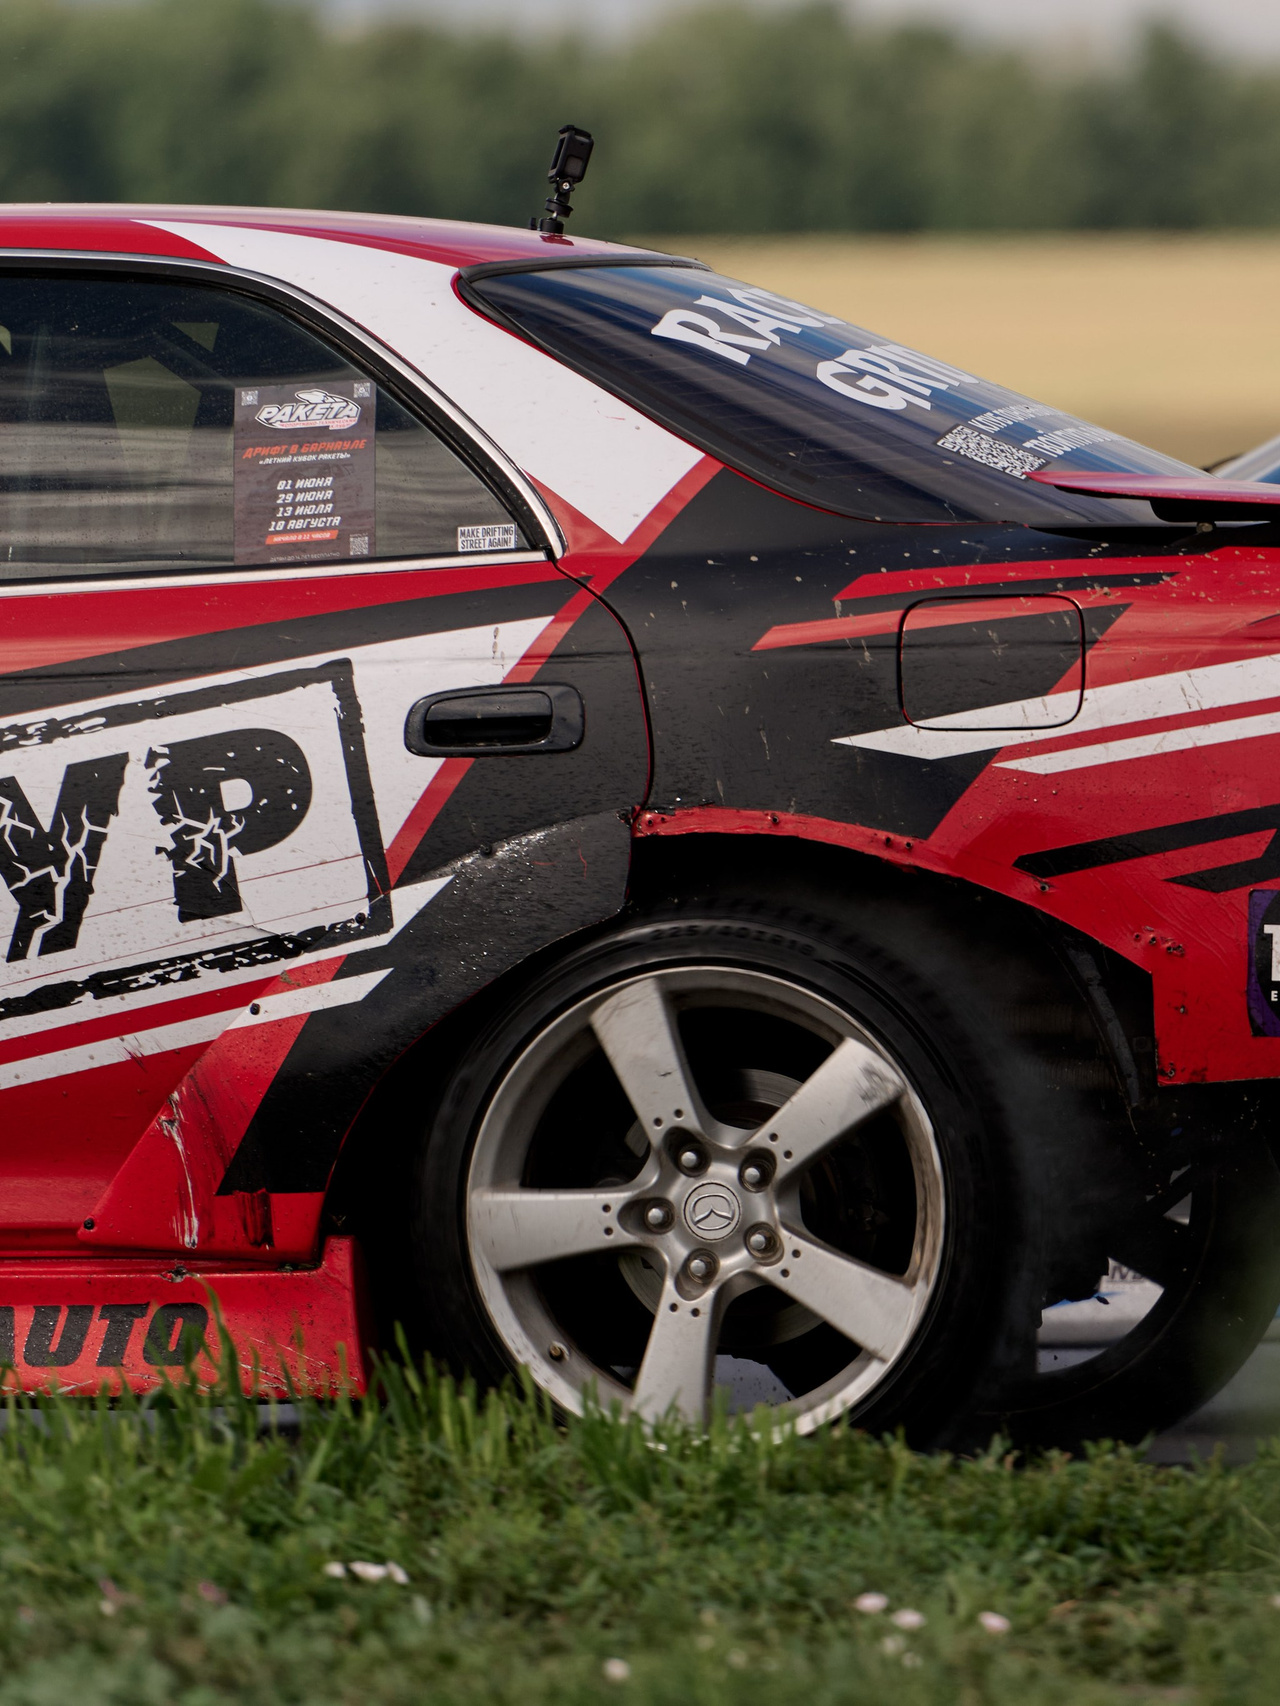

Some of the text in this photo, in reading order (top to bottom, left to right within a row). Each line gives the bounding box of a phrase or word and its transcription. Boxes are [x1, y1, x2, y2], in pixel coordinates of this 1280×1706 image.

[259, 402, 355, 423] РАКЕТА
[242, 439, 368, 459] ДРИФТ В БАРНАУЛЕ
[292, 455, 318, 463] КУБОК
[276, 476, 334, 490] 01 ИЮНЯ
[276, 490, 334, 504] 29 ИЮНЯ
[276, 503, 334, 517] 13 ИЮЛЯ
[268, 516, 341, 531] 10 АВГУСТА
[459, 526, 514, 538] MAKE DRIFTING
[460, 537, 512, 550] STREET AGAIN!
